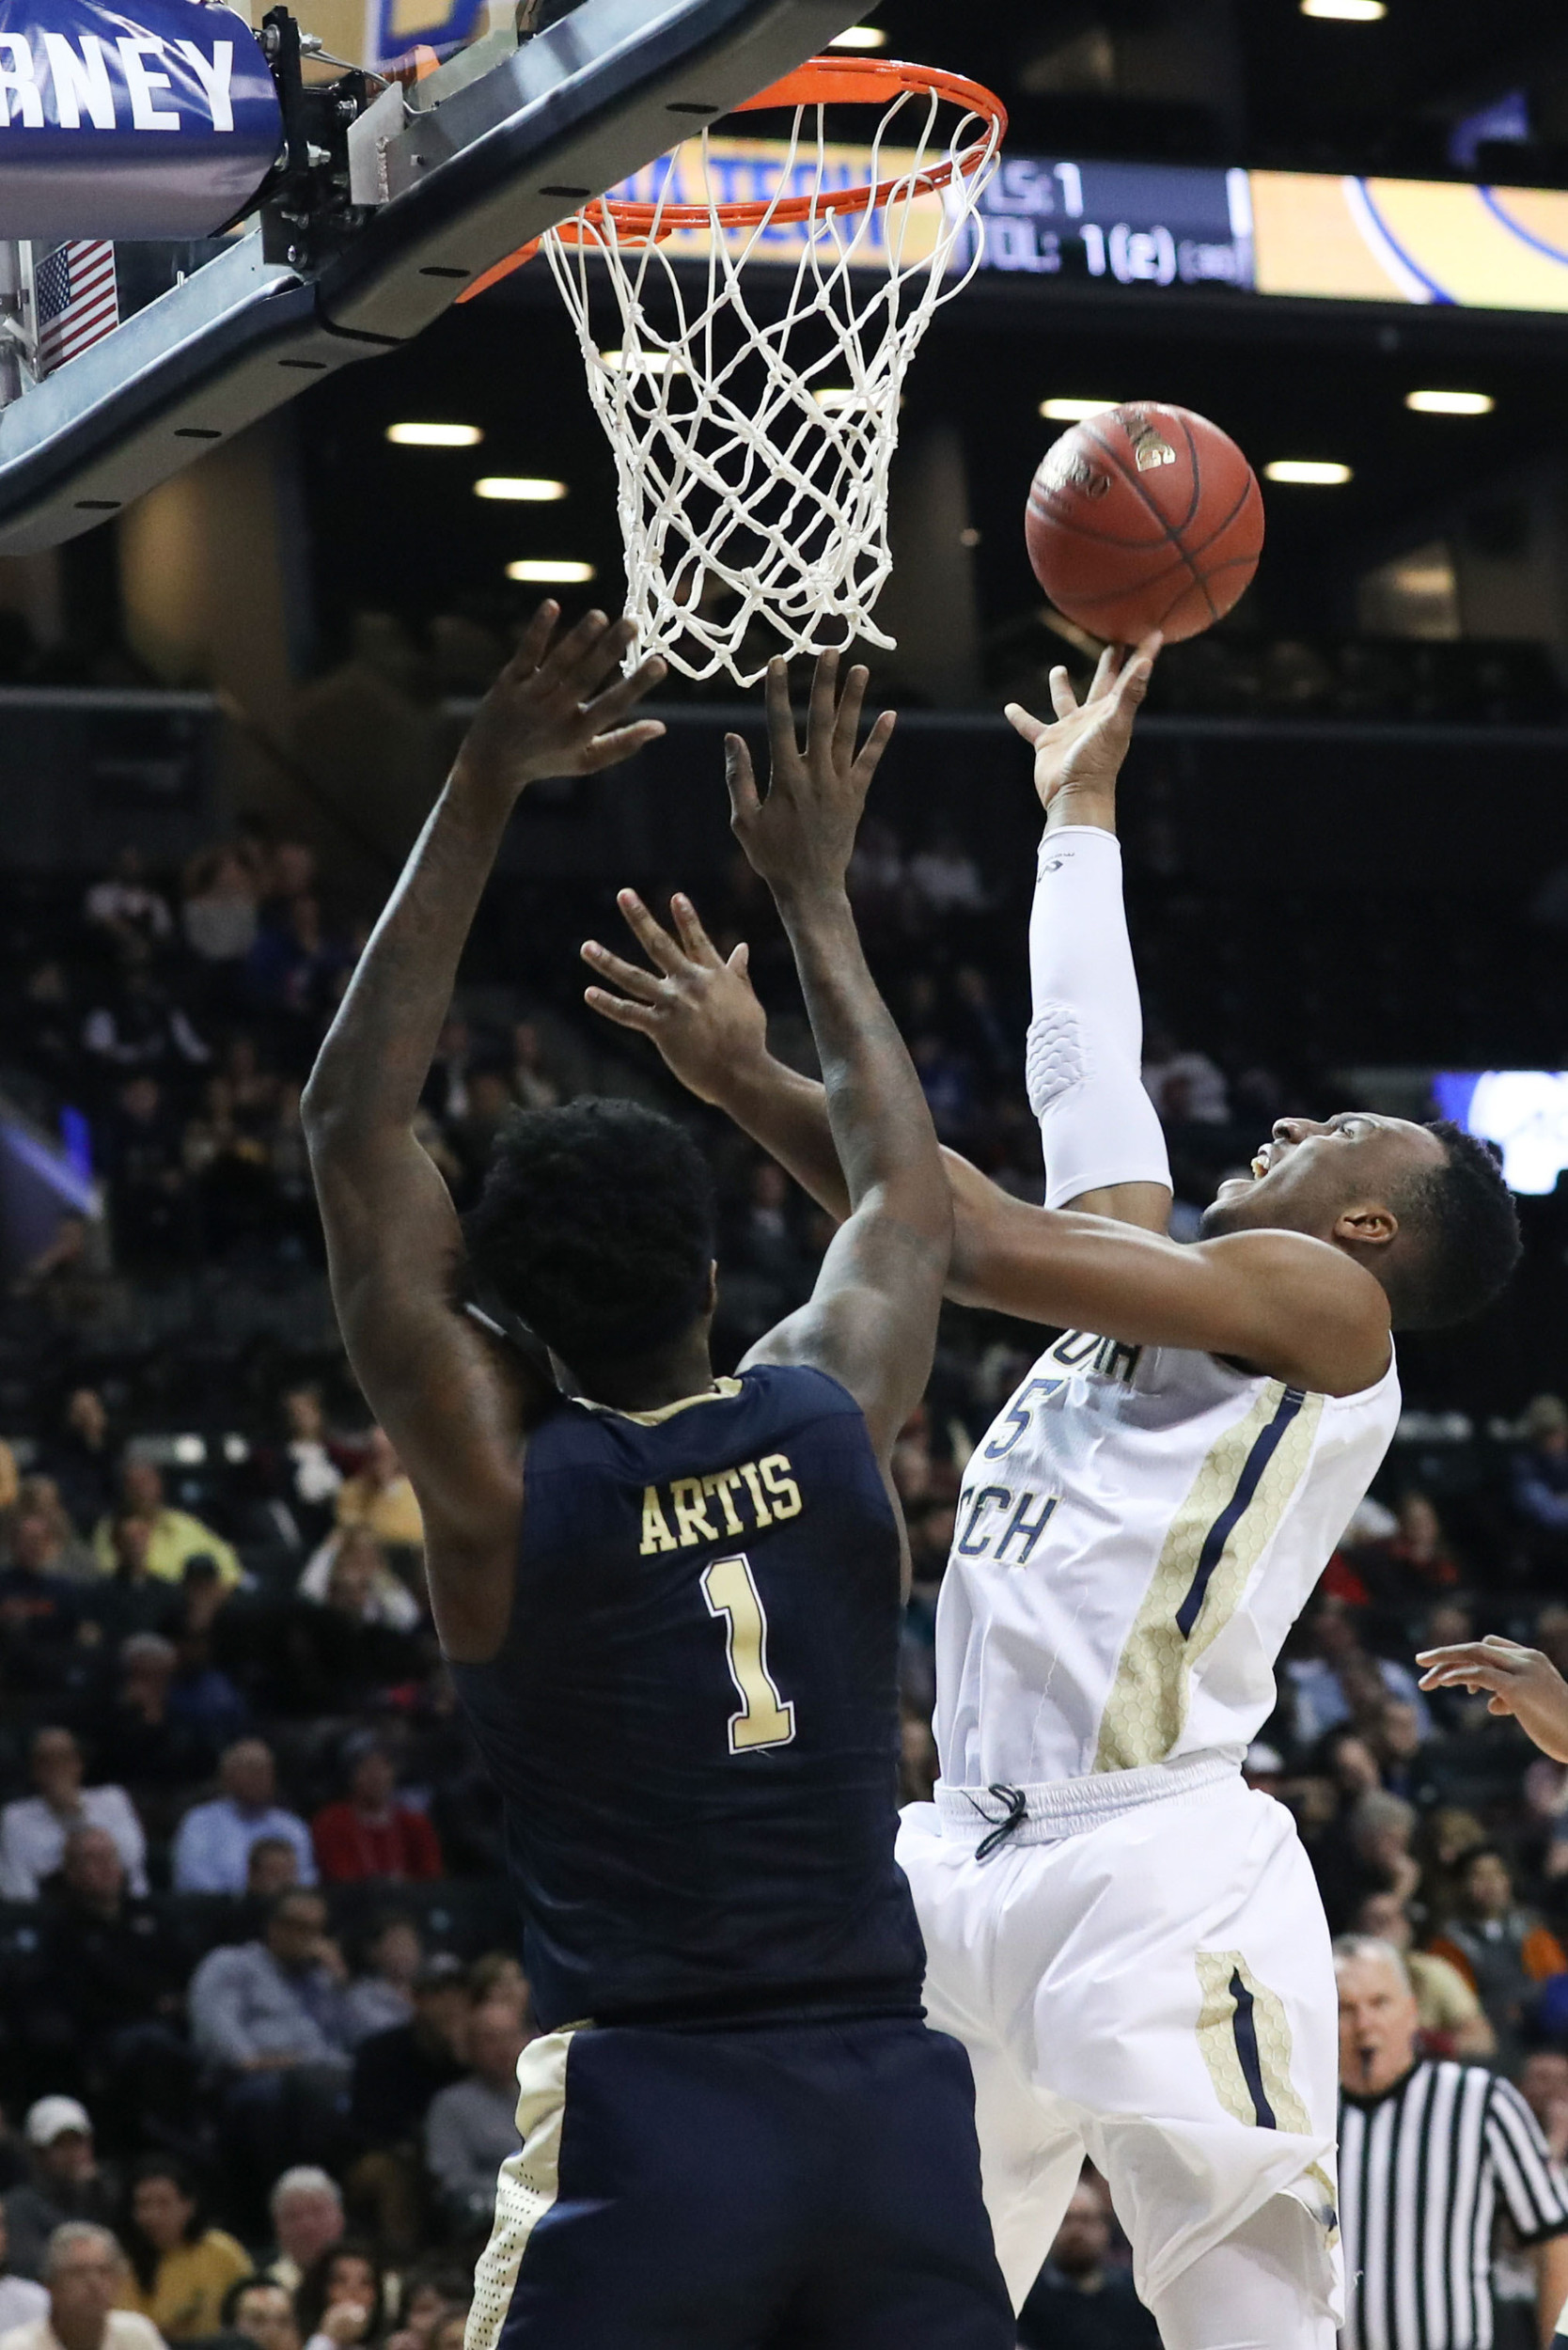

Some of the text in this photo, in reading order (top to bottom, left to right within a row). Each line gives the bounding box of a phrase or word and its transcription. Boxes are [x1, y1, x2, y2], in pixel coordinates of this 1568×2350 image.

[0, 32, 234, 132] RNEY
[639, 1453, 802, 1555] ARTIS
[699, 1552, 796, 1755] 1
